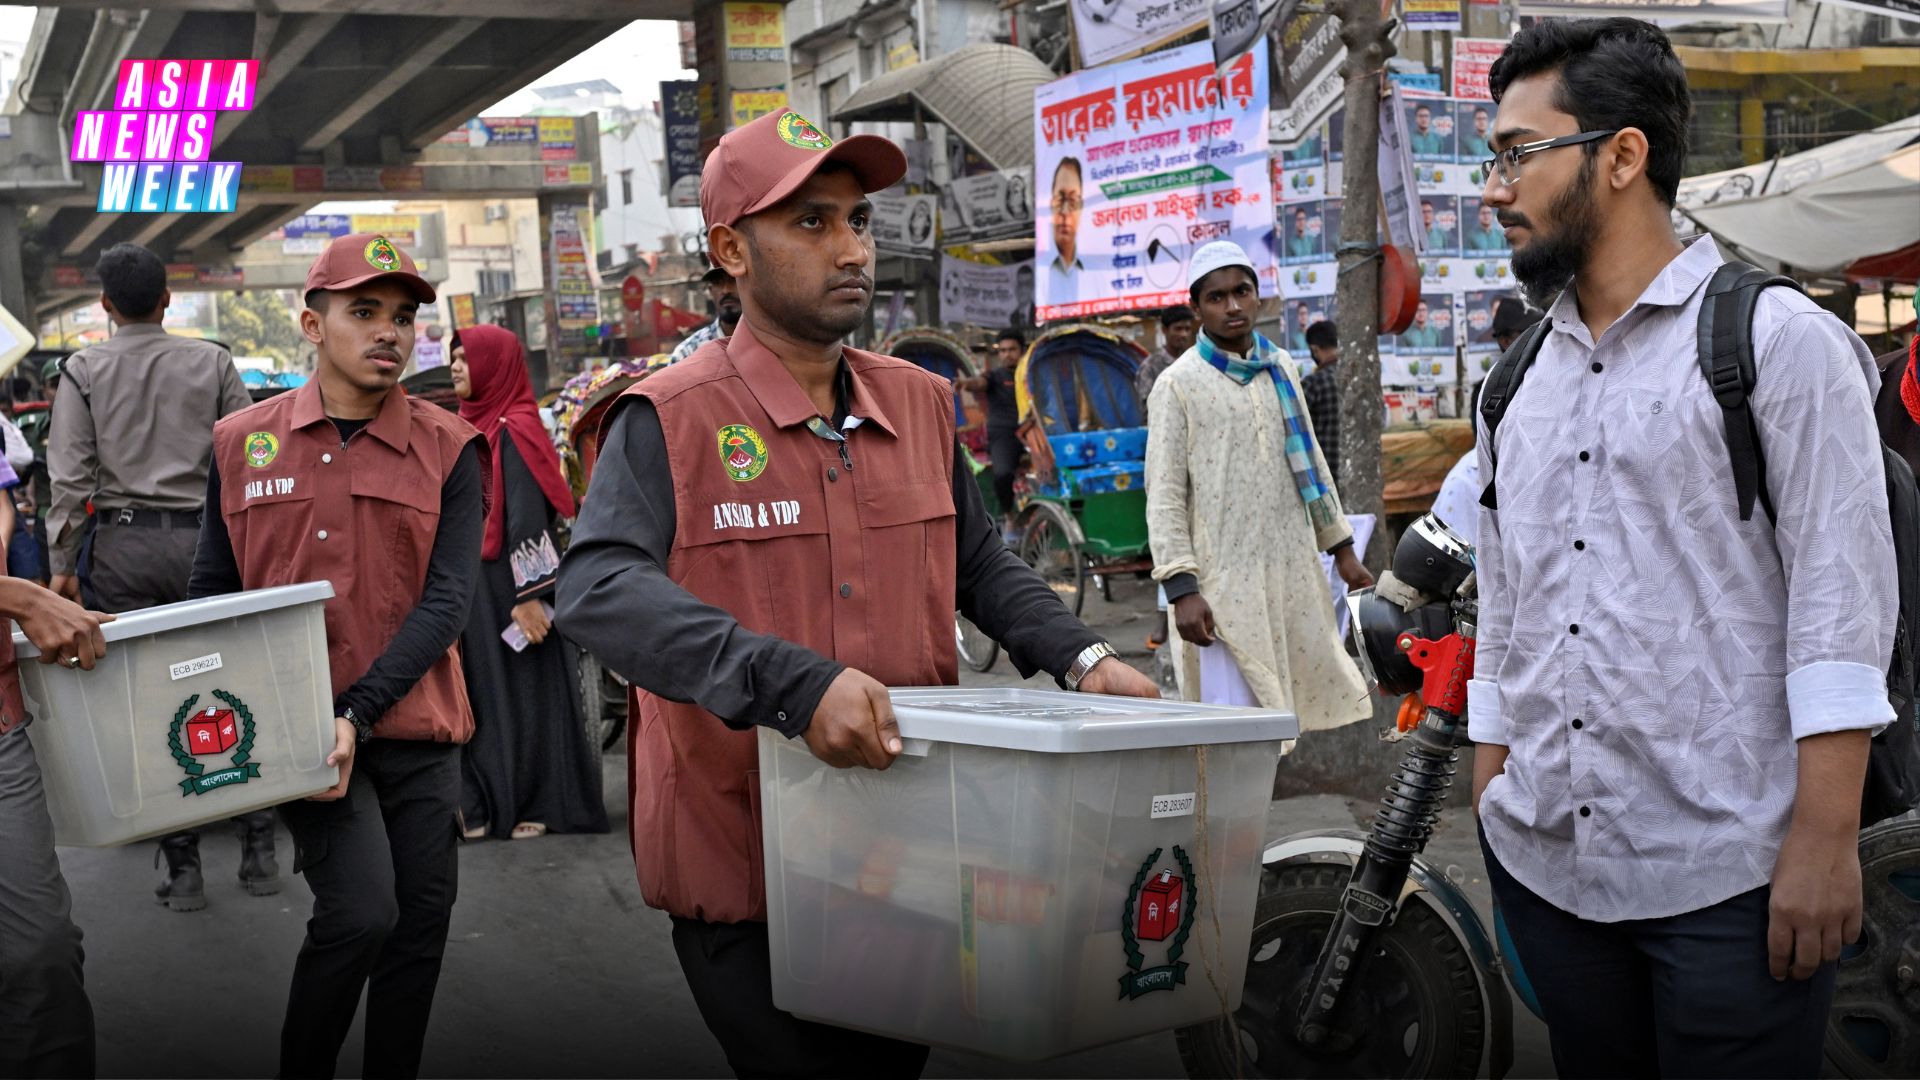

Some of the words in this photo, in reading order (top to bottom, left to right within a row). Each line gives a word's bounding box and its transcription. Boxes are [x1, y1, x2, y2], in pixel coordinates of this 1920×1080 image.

[1041, 87, 1117, 145] তারেক
[1123, 52, 1255, 131] রহমানের
[1092, 203, 1148, 228] জননেতা
[1153, 193, 1206, 220] সাইফুল
[1212, 187, 1243, 209] হক
[1187, 220, 1231, 244] কোদাল
[265, 480, 273, 496] &
[275, 478, 294, 495] VDP
[713, 503, 754, 530] ANSAR
[758, 503, 769, 527] &
[771, 500, 801, 525] VDP
[173, 664, 191, 677] ECB
[192, 656, 219, 671] 296221
[200, 770, 242, 787] বাংলাদেশ
[1153, 800, 1168, 813] ECB
[1169, 798, 1192, 812] 283607
[1136, 970, 1173, 989] বাংলাদেশ
